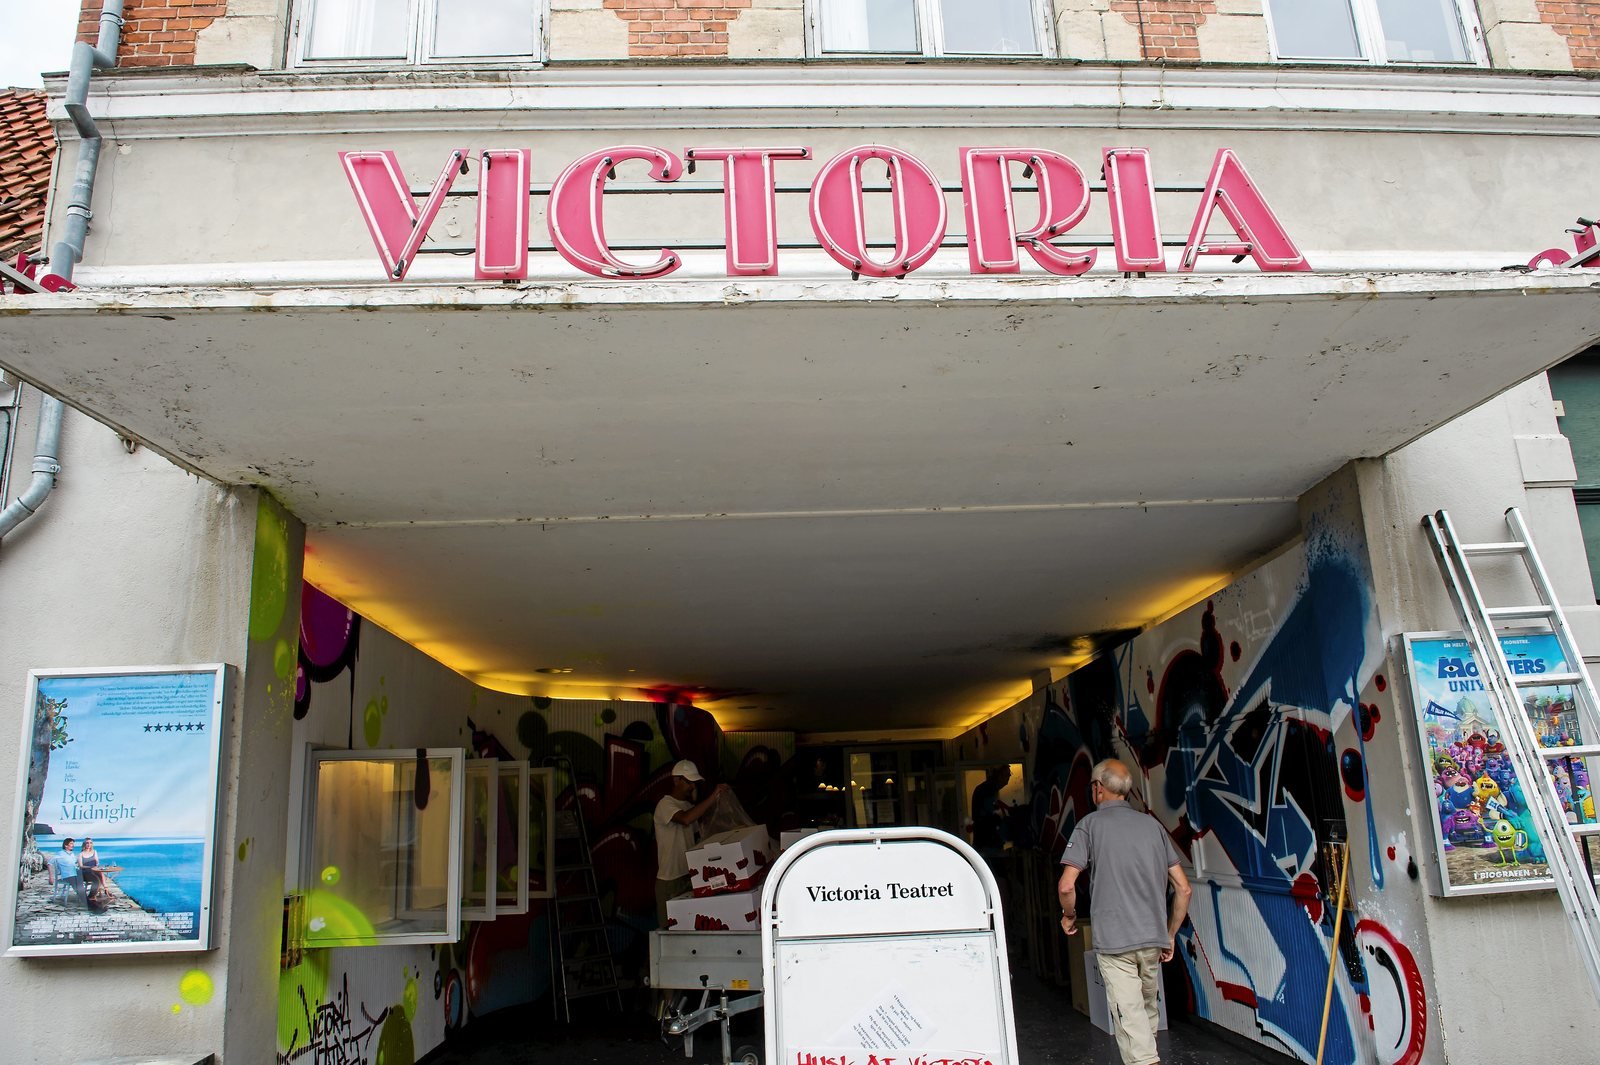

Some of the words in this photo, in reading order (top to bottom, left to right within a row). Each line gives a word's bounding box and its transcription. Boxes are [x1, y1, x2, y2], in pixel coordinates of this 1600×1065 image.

[337, 144, 1314, 281] VICTORIA
[62, 787, 115, 803] Before
[60, 803, 137, 824] Midnight
[1480, 869, 1531, 879] BIOGRAFEN
[806, 884, 881, 902] Victoria
[886, 882, 954, 899] Teatret
